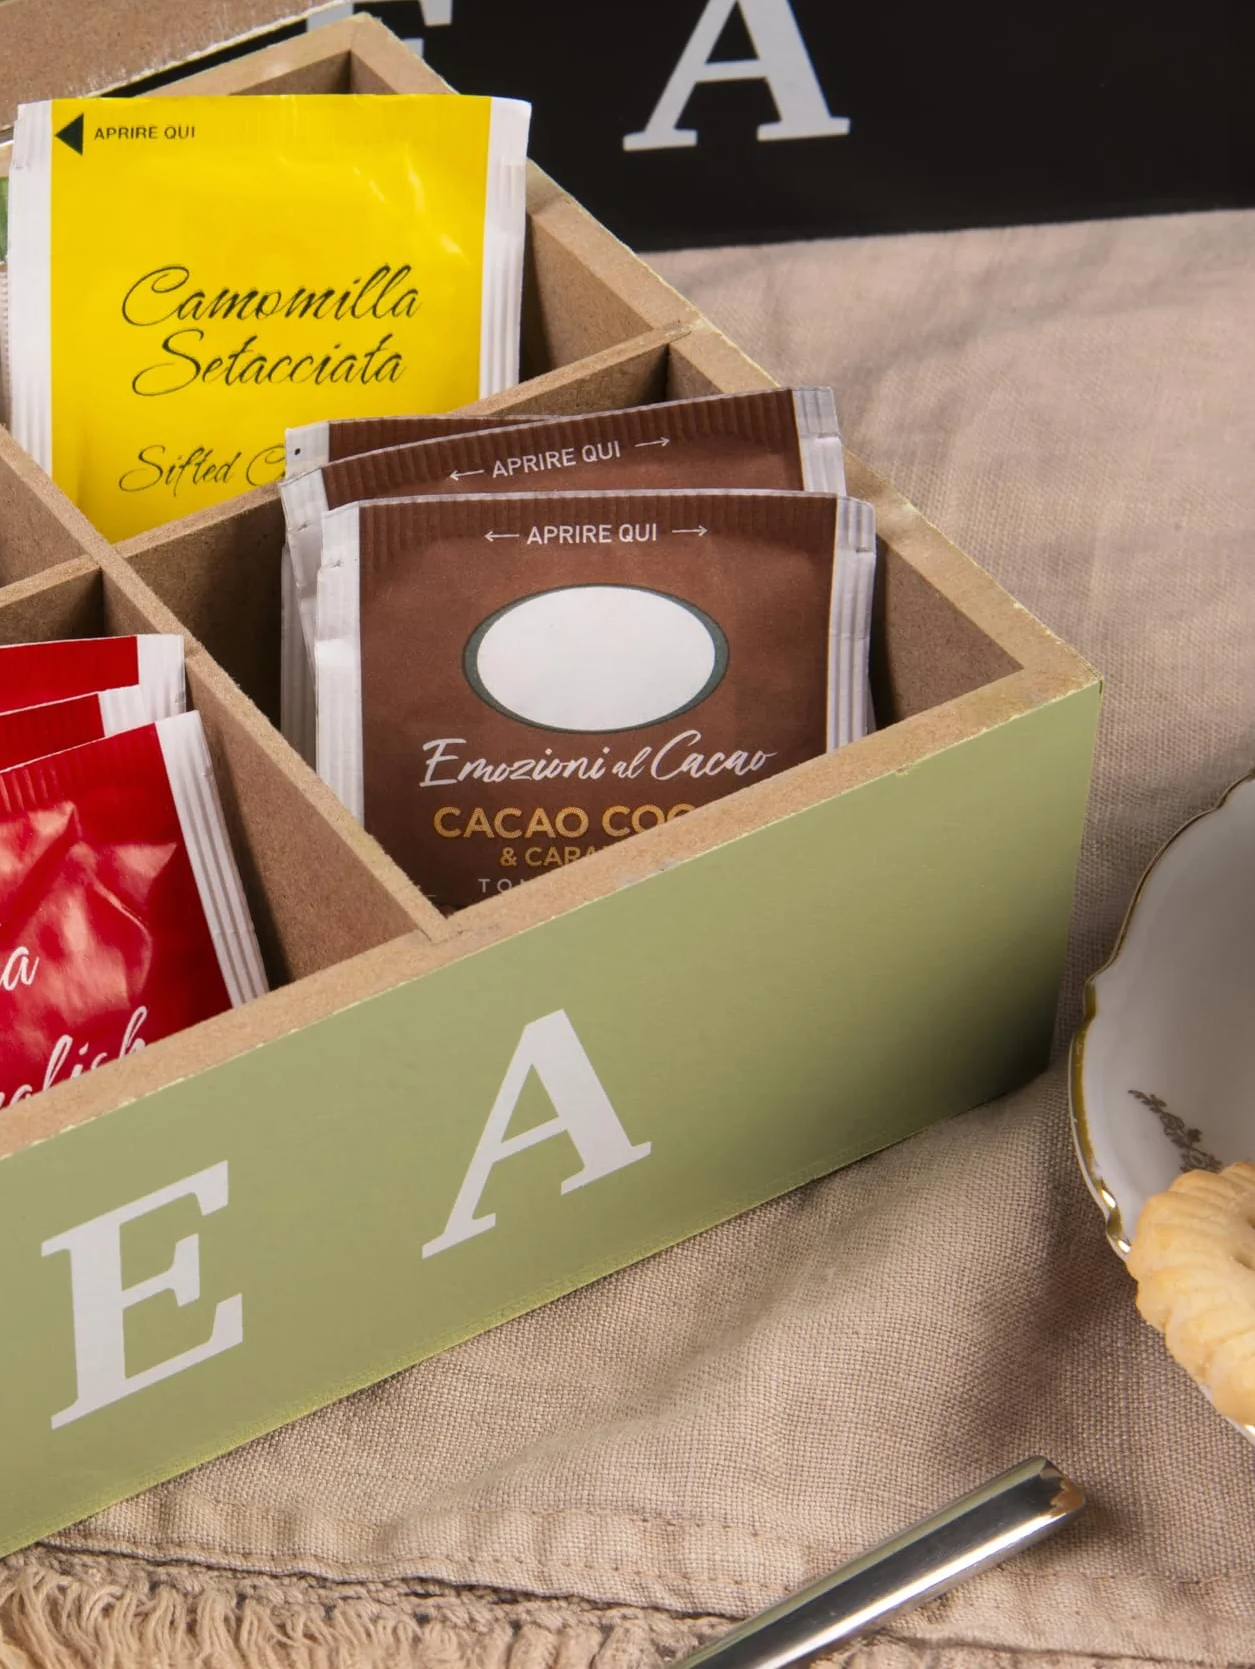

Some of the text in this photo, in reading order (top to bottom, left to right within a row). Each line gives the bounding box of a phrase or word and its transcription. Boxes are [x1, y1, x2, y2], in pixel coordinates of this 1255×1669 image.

[94, 126, 195, 140] APRIRE QUI
[121, 264, 422, 327] Camomilla
[132, 328, 408, 397] Setacciata
[119, 444, 242, 498] Sifted
[492, 441, 621, 479] APRIRE QUI
[526, 523, 657, 545] APRIRE QUI
[419, 730, 777, 788] Emozioni al Cacao
[433, 807, 589, 838] CACAO
[498, 847, 518, 867] &
